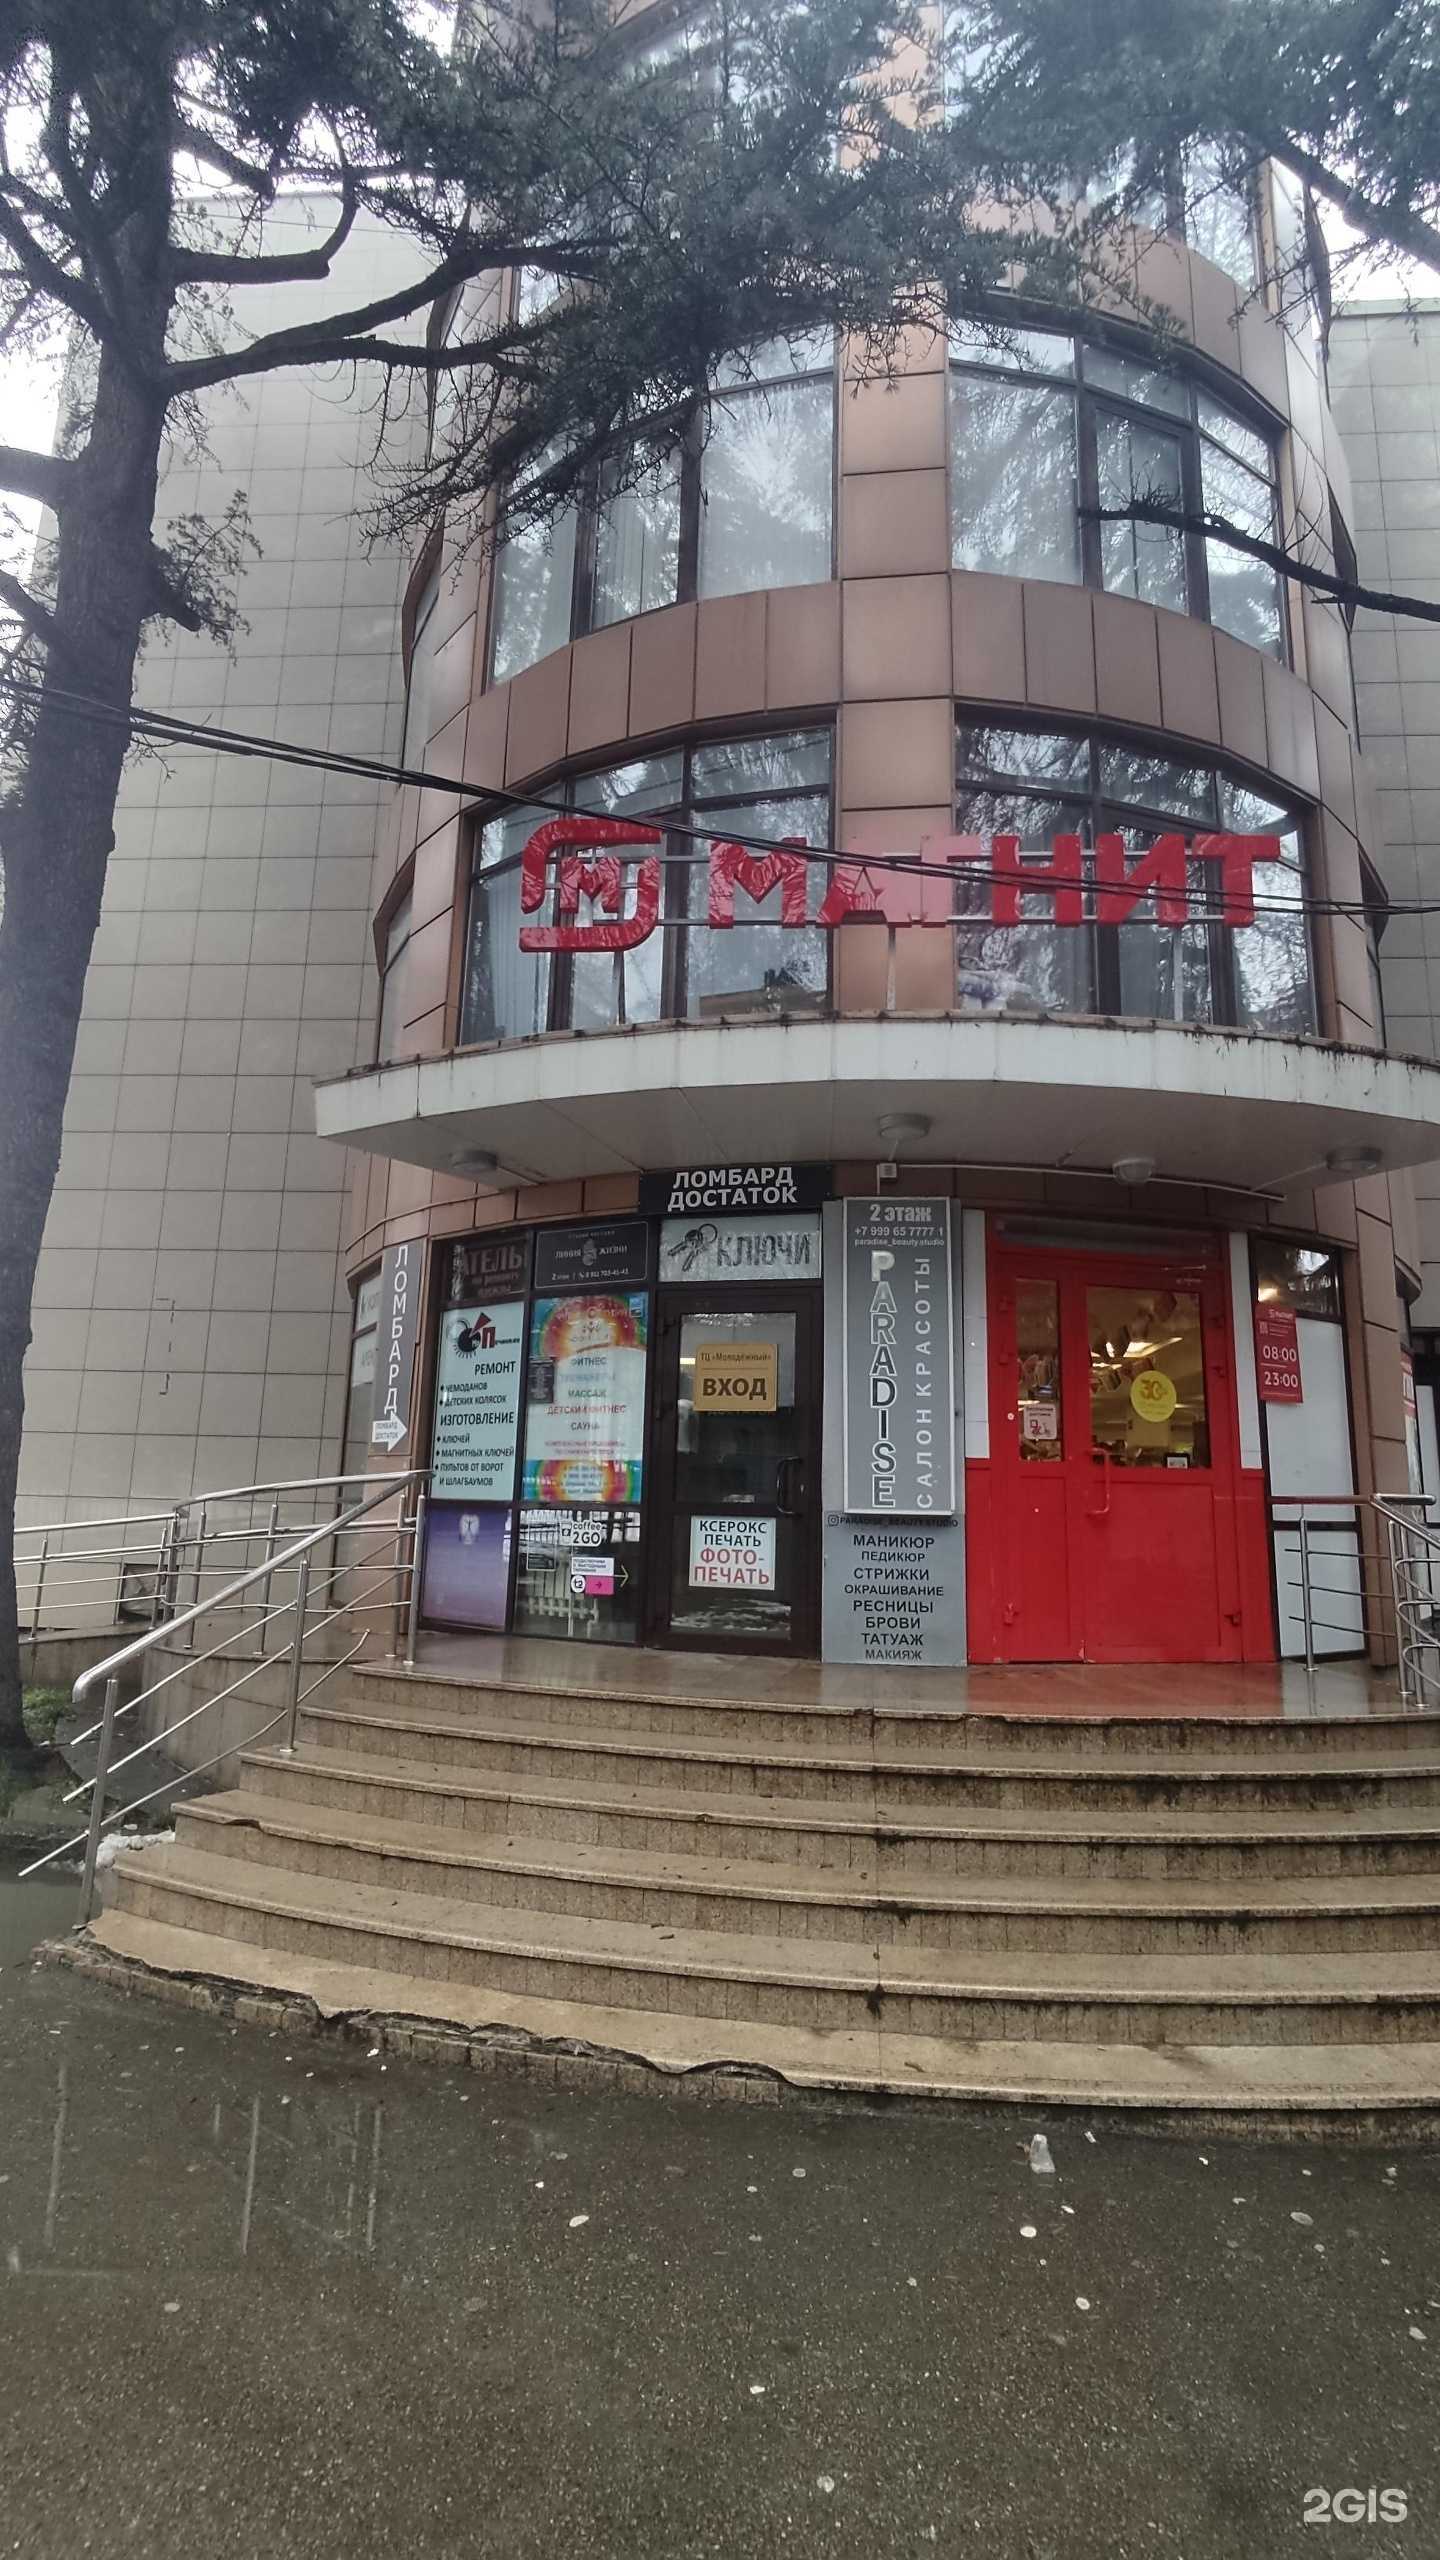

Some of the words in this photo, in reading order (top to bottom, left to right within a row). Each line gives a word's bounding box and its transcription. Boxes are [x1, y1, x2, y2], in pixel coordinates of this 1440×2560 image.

[673, 1167, 794, 1189] ЛОМБАРД
[667, 1186, 798, 1212] ДОСТАТОК
[870, 1203, 881, 1221] 2
[884, 1206, 932, 1222] этаж
[855, 1226, 868, 1236] +7
[870, 1226, 890, 1236] 999
[893, 1226, 906, 1236] 65
[908, 1226, 935, 1237] 7777
[716, 1234, 811, 1267] КЛЮЧИ
[384, 1244, 409, 1416] ЛОМБАРД
[914, 1257, 932, 1398] КРАСОТЫ
[1262, 1345, 1297, 1362] 08:00
[474, 1360, 516, 1376] РЕМОНТ
[870, 1250, 898, 1508] PARADISE
[1264, 1371, 1298, 1388] 23:00
[445, 1382, 488, 1392] ЧЕМОДАНОВ
[702, 1378, 767, 1400] ВХОД
[444, 1396, 473, 1407] ДЕТСКИХ
[475, 1394, 507, 1405] КОЛЯСОК
[440, 1411, 515, 1427] ИЗГОТОВЛЕНИЕ
[442, 1433, 470, 1444] КЛЮЧЕЙ
[441, 1448, 483, 1458] МАГНИТНЫХ
[484, 1446, 514, 1457] КЛЮЧЕЙ
[916, 1408, 934, 1509] САЛОН
[440, 1462, 469, 1472] ПУЛЬТОВ
[470, 1462, 480, 1472] ОТ
[480, 1462, 504, 1472] ВОРОТ
[445, 1476, 494, 1486] ШЛАГБАУМОВ
[573, 1522, 601, 1531] coffee
[700, 1520, 768, 1534] КСЕРОКС
[704, 1534, 762, 1547] ПЕЧАТЬ
[853, 1534, 935, 1549] МАНИКЮР
[700, 1547, 765, 1565] ФОТО-
[861, 1551, 926, 1563] ПЕДИКЮР
[694, 1566, 769, 1585] ПЕЧАТЬ
[853, 1567, 930, 1581] СТРИЖКИ
[844, 1584, 944, 1597] ОКРАШИВАНИЕ
[853, 1600, 933, 1615] РЕСНИЦЫ
[865, 1616, 920, 1629] БРОВИ
[861, 1633, 924, 1646] ТАТУАЖ
[865, 1649, 922, 1660] МАКИЯЖ
